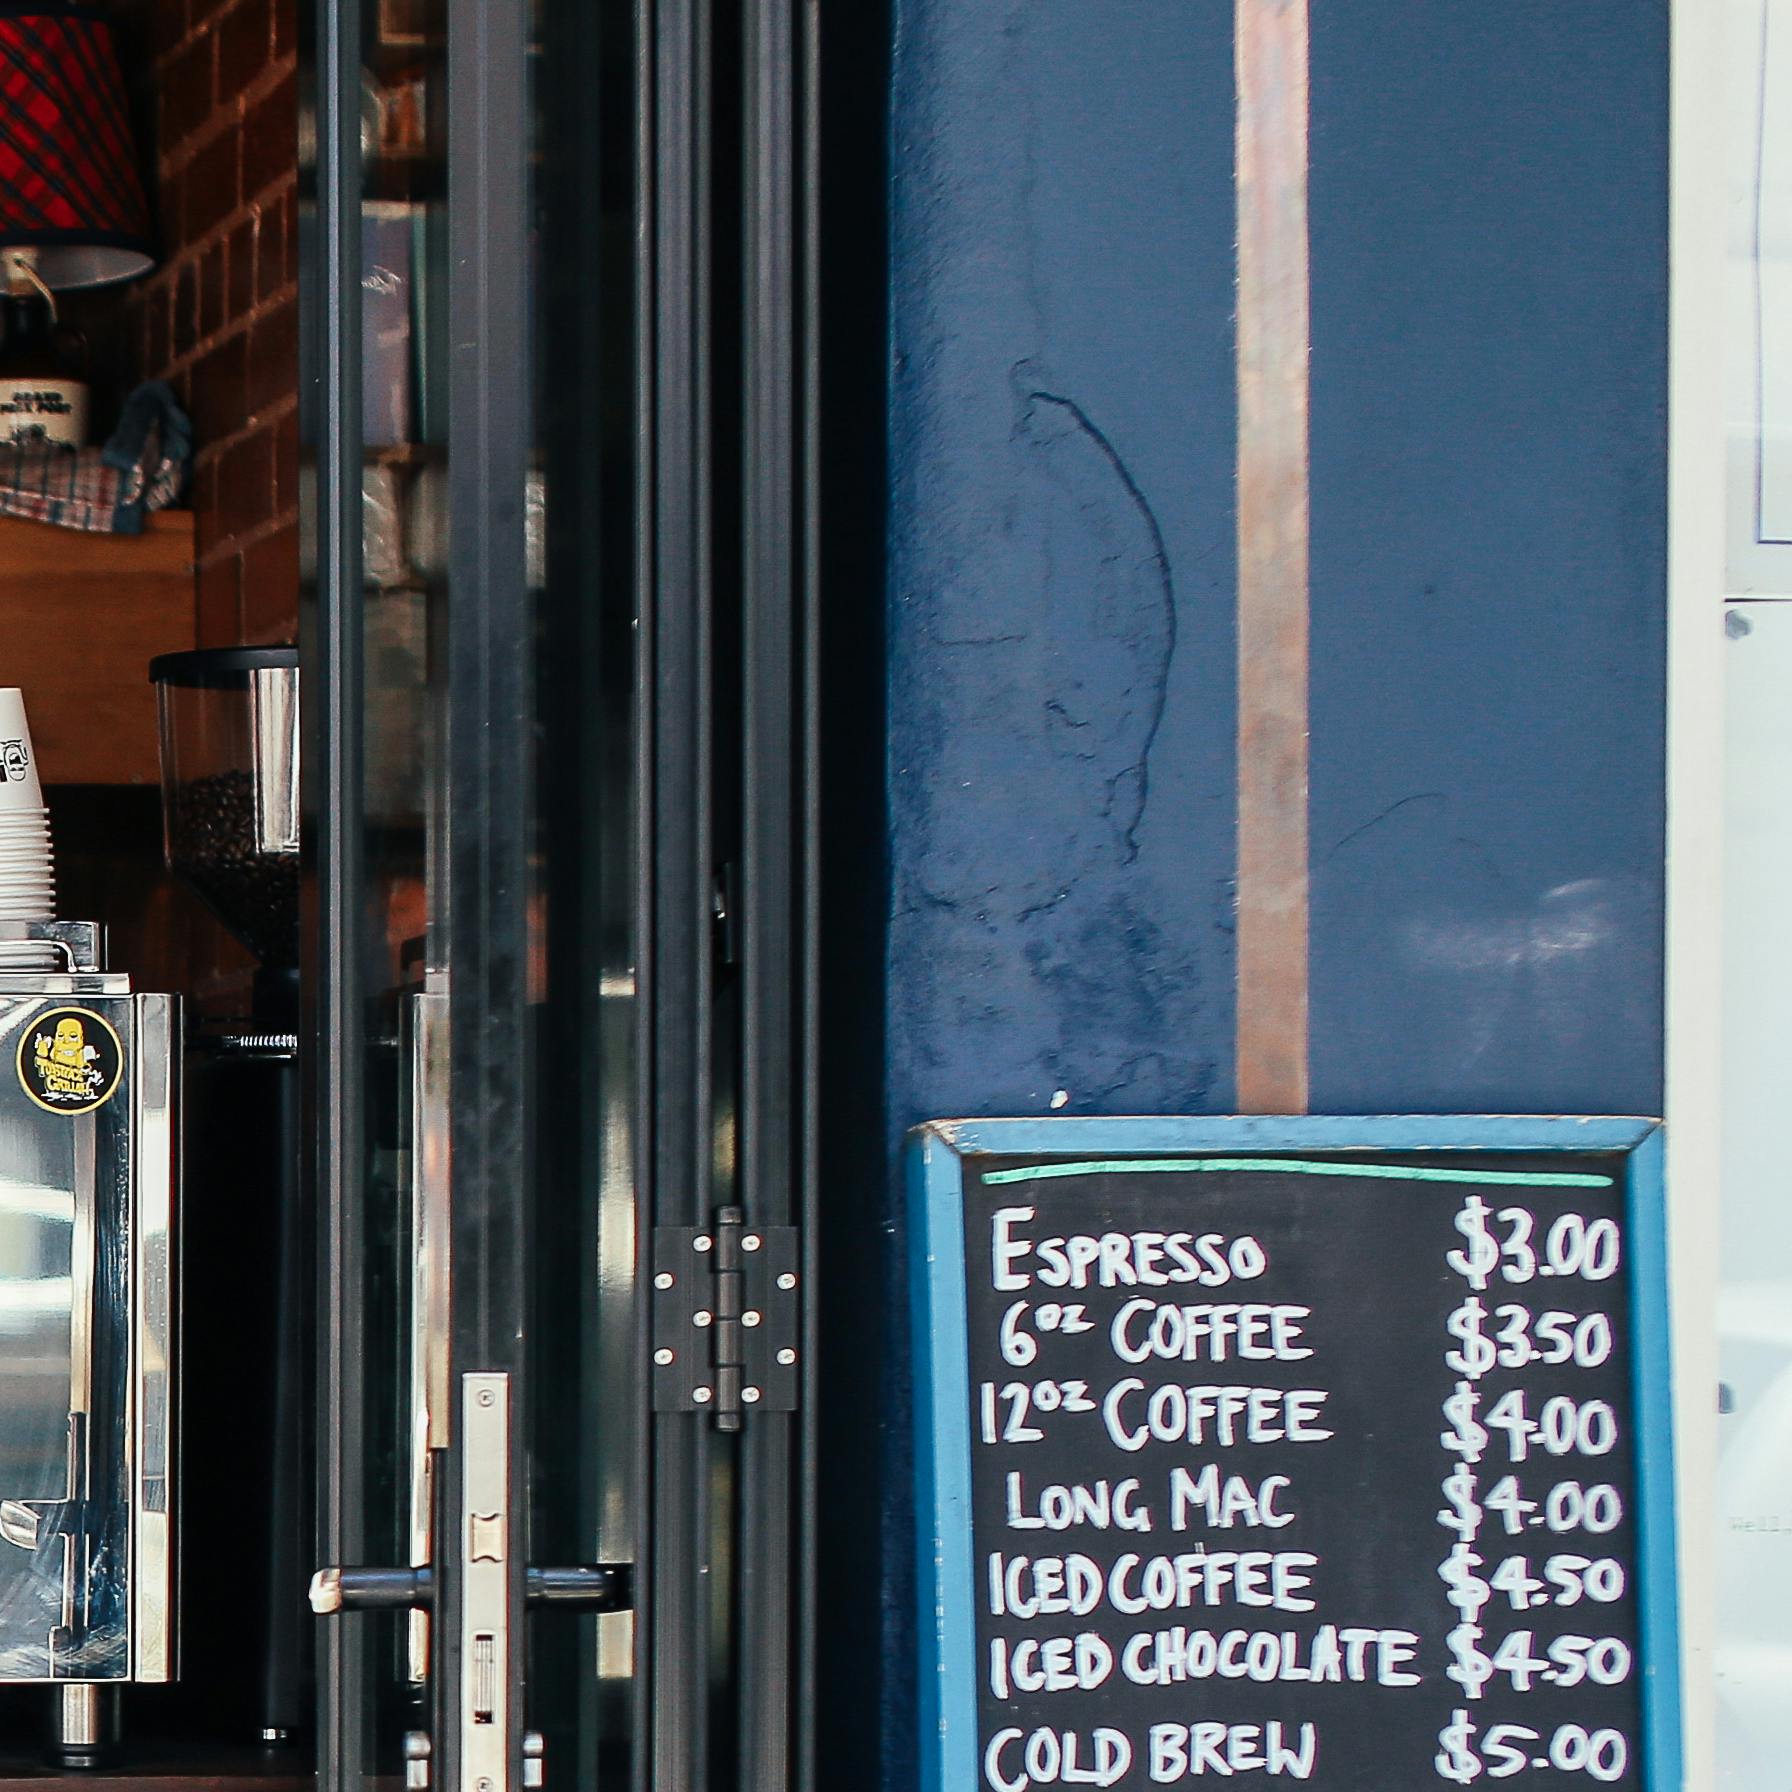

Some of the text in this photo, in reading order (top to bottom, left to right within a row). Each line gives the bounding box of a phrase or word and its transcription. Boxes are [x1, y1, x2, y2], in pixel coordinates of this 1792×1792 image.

[991, 1195, 1620, 1292] ESPRESSO $3.00
[1111, 1296, 1613, 1380] COFFEE $3.50
[1103, 1377, 1617, 1464] COFFEE $4.00
[989, 1622, 1632, 1700] ICED CHOCOLATE $4.50
[1148, 1719, 1316, 1784] BREW
[1435, 1709, 1628, 1784] $5.00
